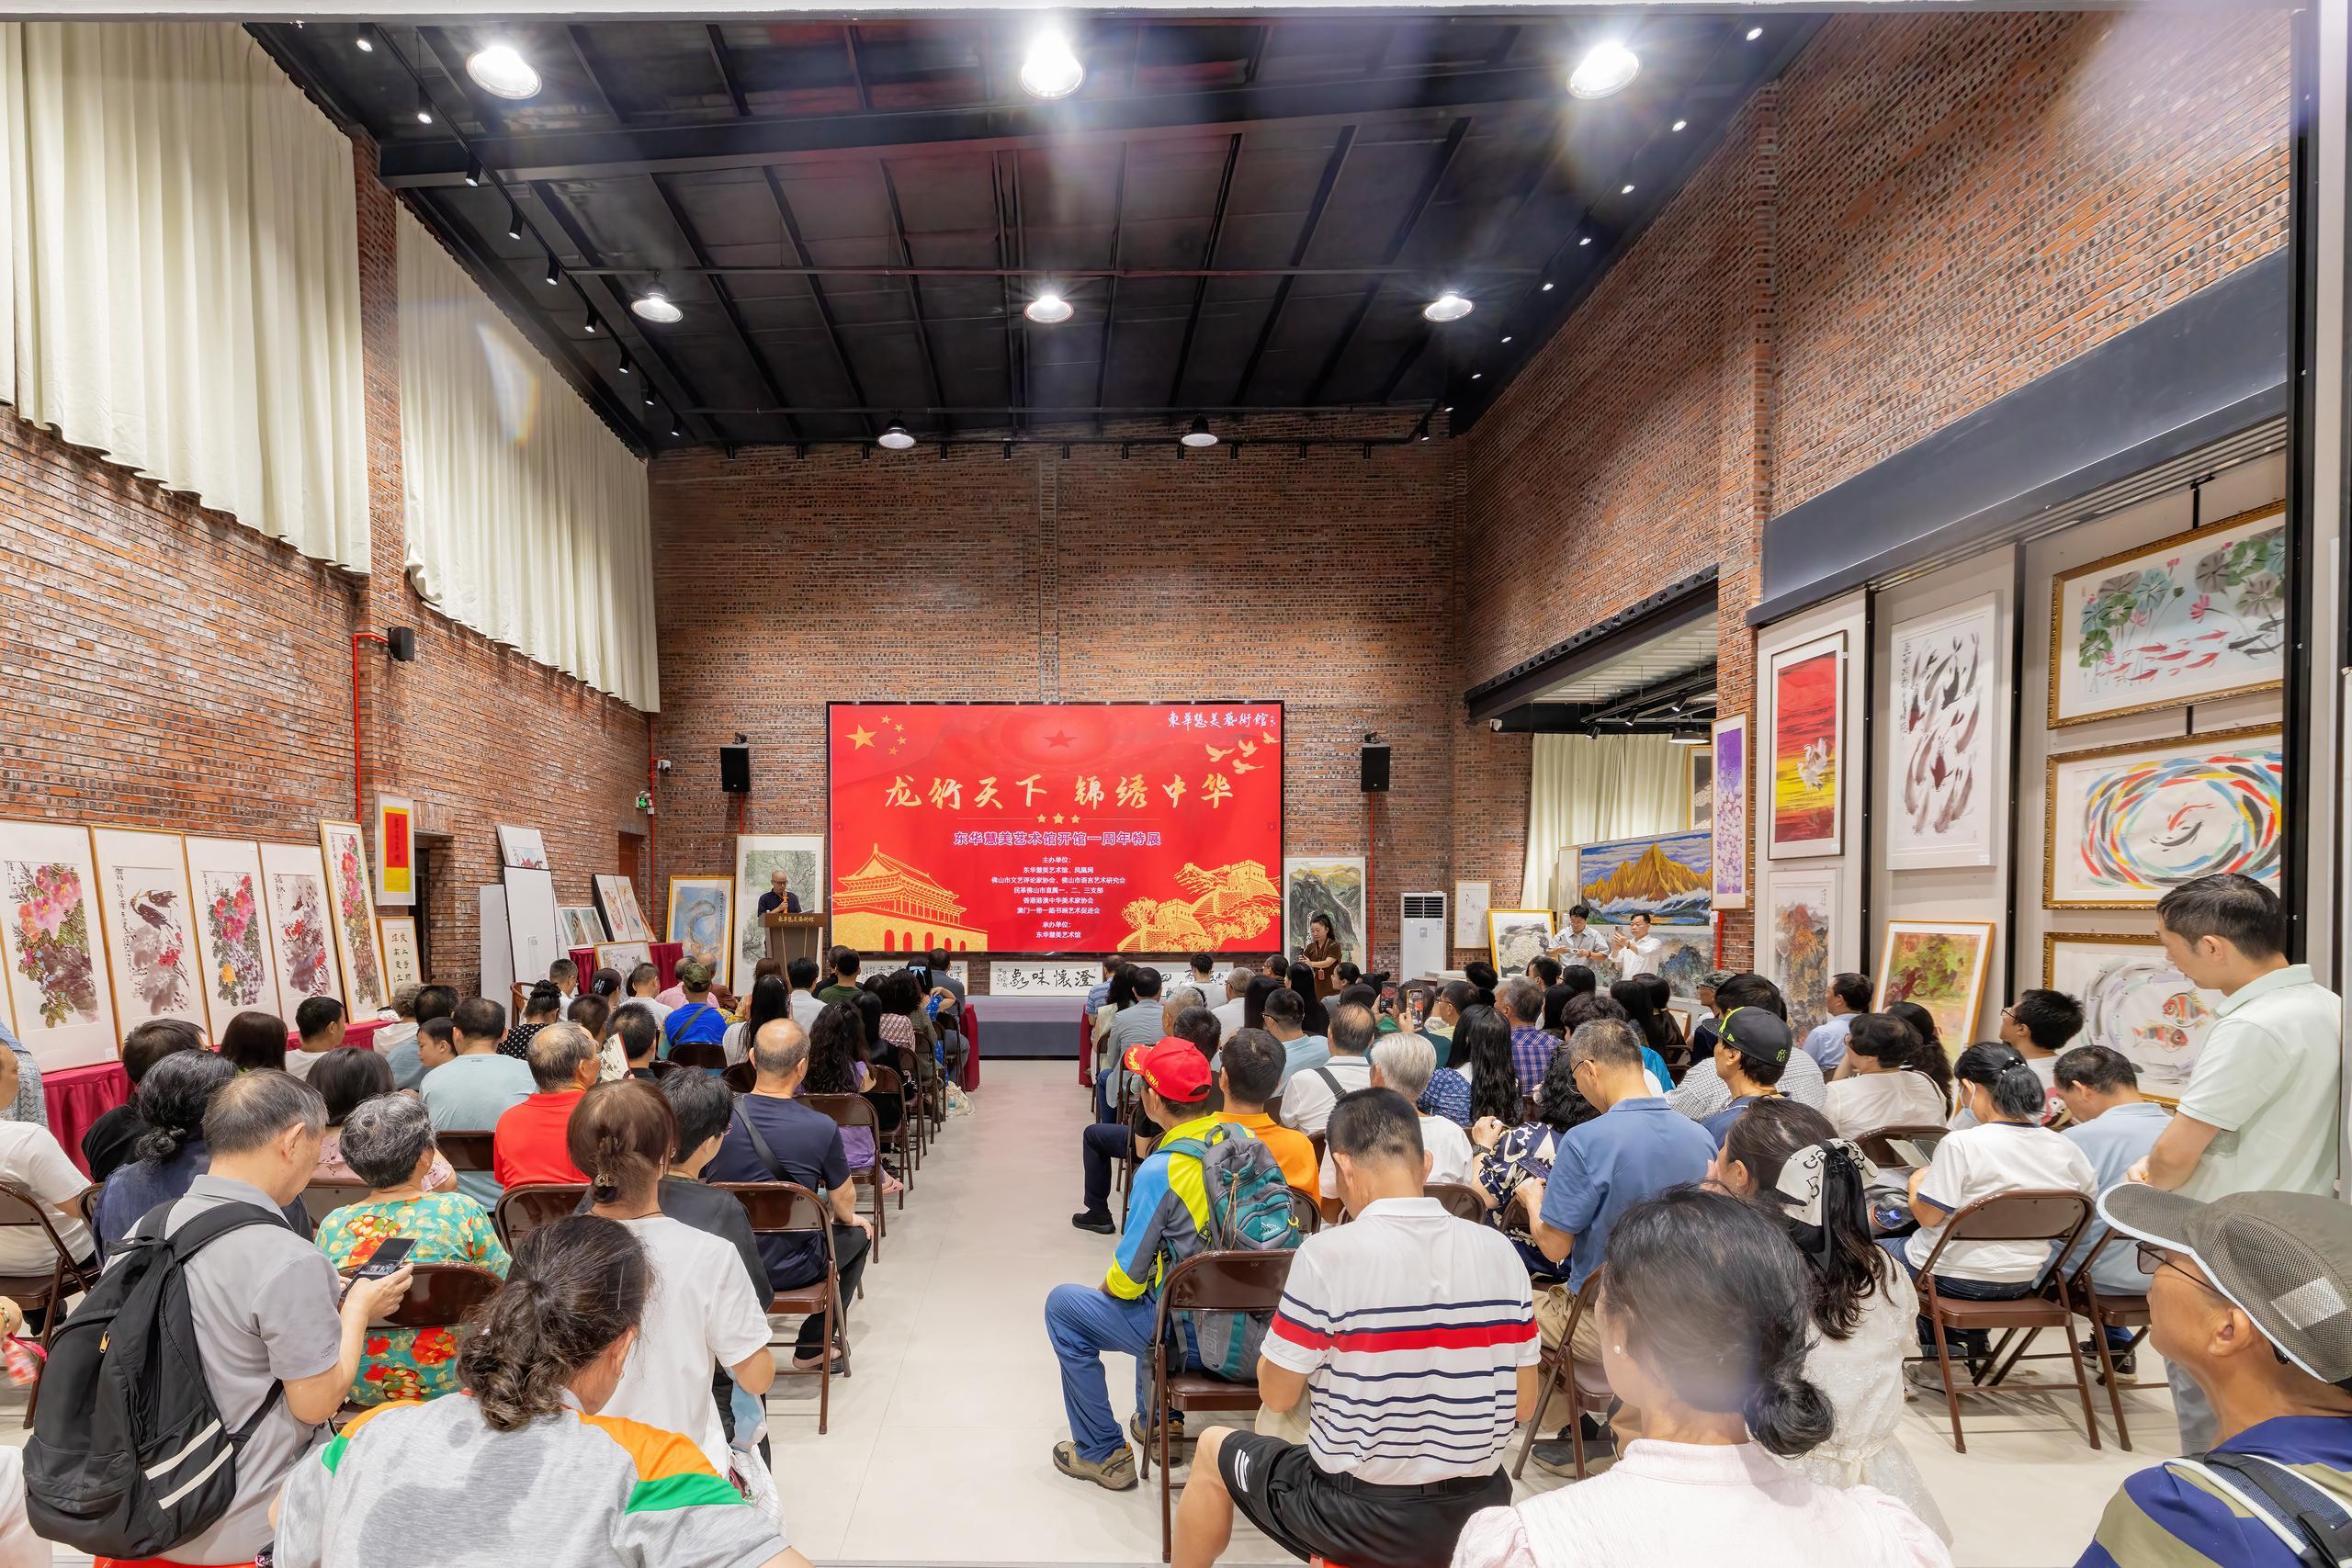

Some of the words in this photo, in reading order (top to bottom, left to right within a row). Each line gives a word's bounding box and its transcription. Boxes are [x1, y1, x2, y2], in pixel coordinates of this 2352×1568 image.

[885, 773, 1047, 809] 龙行天下
[1074, 773, 1234, 809] 锦绣中华
[954, 831, 1162, 846] 东华慧美艺术馆开馆一周年特展
